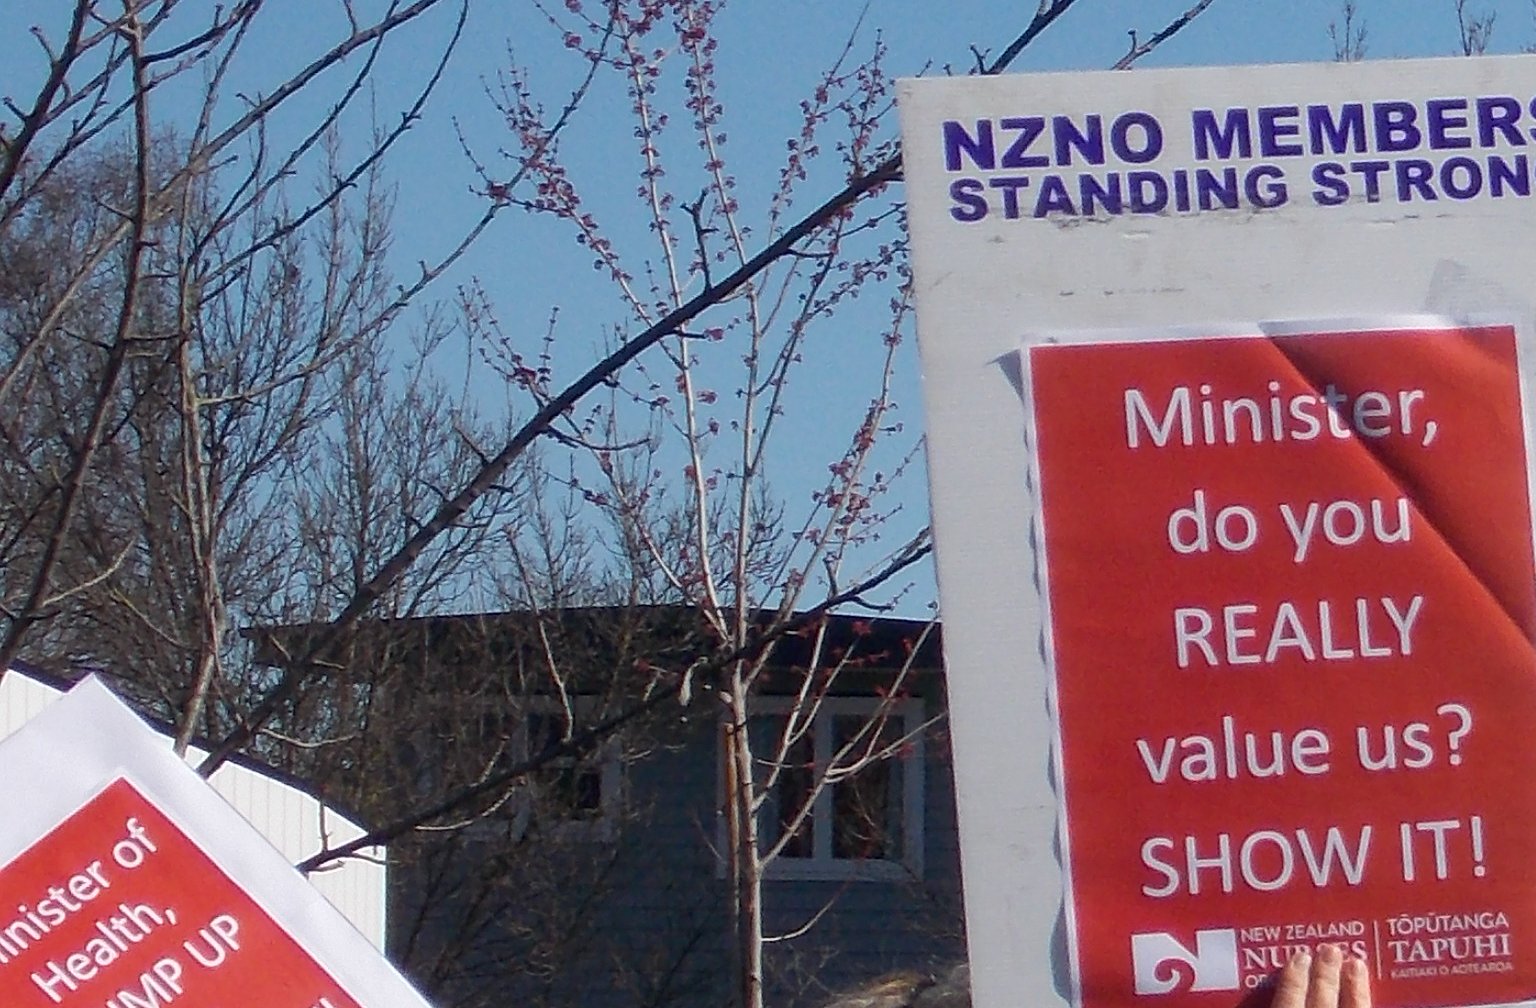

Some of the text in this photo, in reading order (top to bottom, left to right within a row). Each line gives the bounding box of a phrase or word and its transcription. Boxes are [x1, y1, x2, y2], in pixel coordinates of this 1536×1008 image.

[942, 110, 1164, 171] NZNO
[948, 164, 1288, 223] STANDING
[1124, 380, 1439, 447] Minister,
[1169, 490, 1411, 562] do you
[1174, 596, 1423, 668] REALLY
[1136, 704, 1473, 784] value us?
[112, 817, 158, 869] of
[1141, 816, 1486, 897] SHOW IT!
[31, 903, 177, 1003] Health,
[183, 914, 241, 969] UP
[1241, 920, 1365, 943] NEW ZEALAND
[1388, 933, 1512, 962] TAPUHI
